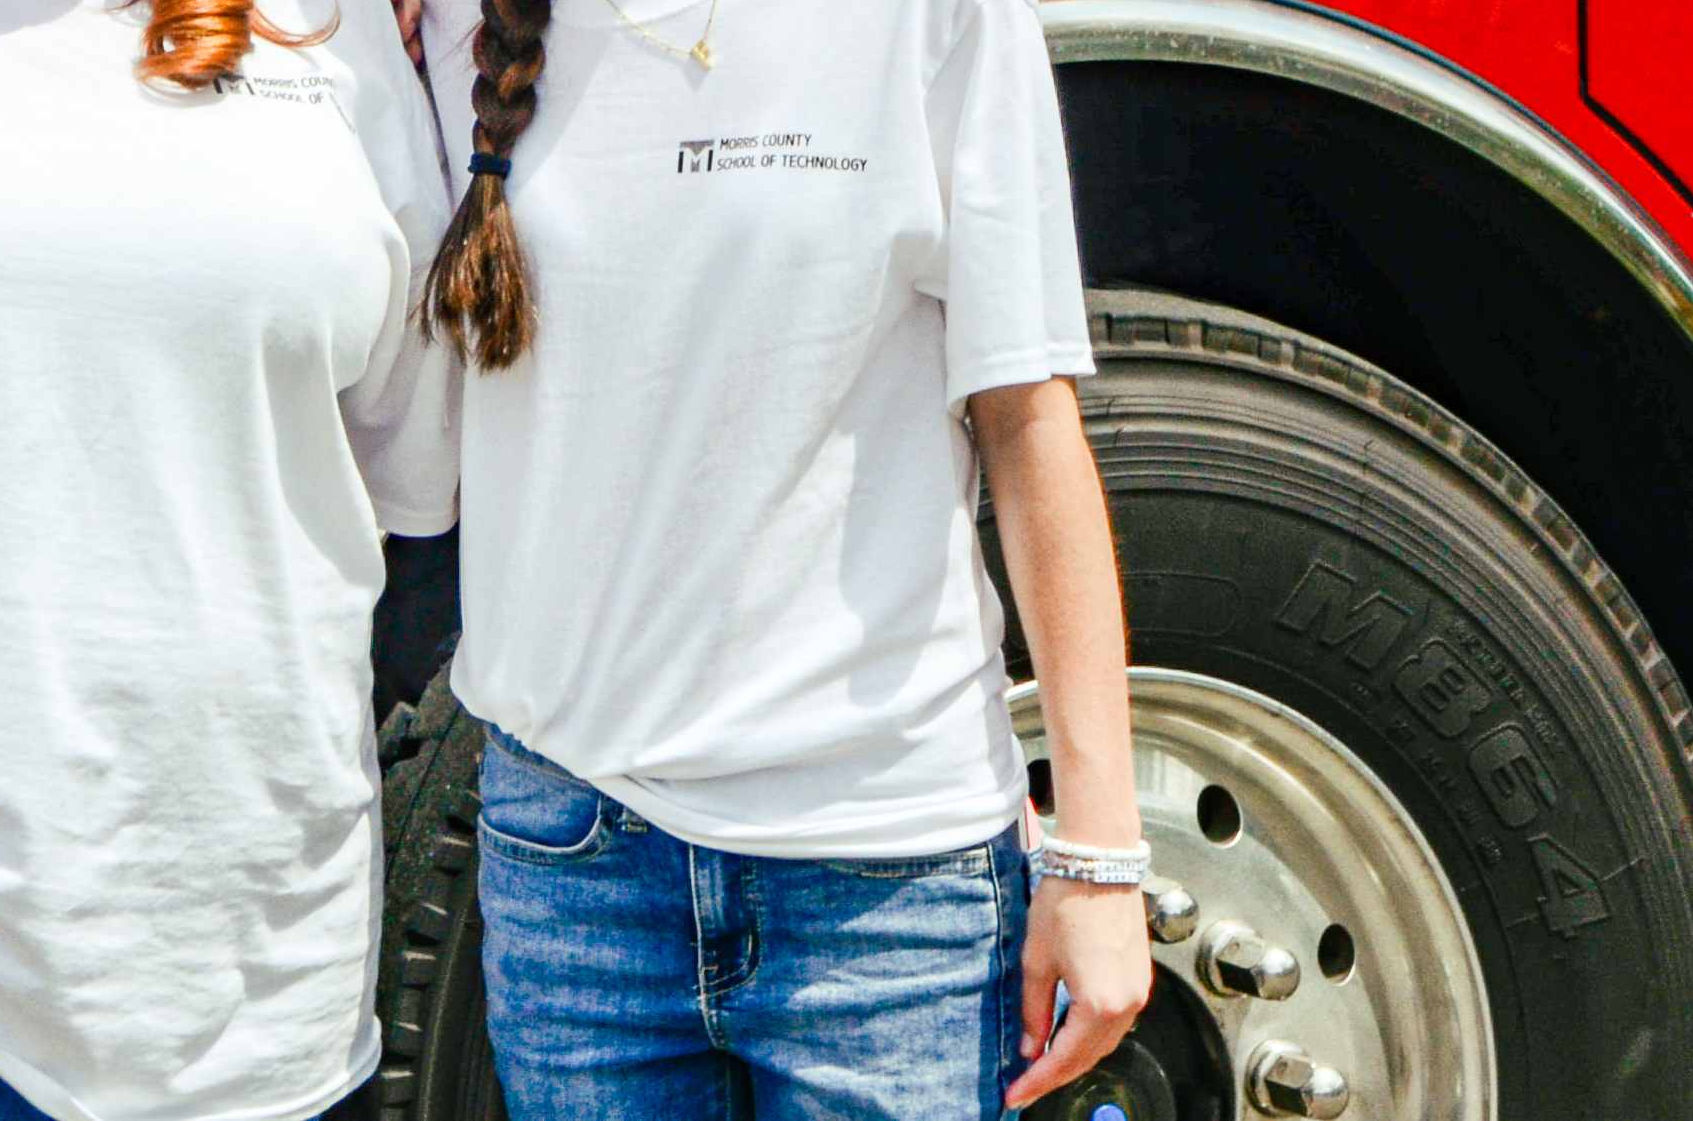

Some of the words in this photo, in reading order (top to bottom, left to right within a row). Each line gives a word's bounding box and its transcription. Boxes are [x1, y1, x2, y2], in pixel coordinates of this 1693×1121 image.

[301, 76, 337, 90] COUN
[308, 91, 324, 104] OF
[719, 136, 759, 151] MORRIS
[762, 133, 812, 147] COUNTY
[717, 155, 756, 172] SCHOOL
[761, 154, 776, 167] OF
[782, 154, 868, 172] TECHNOLOGY
[1273, 561, 1612, 940] M864
